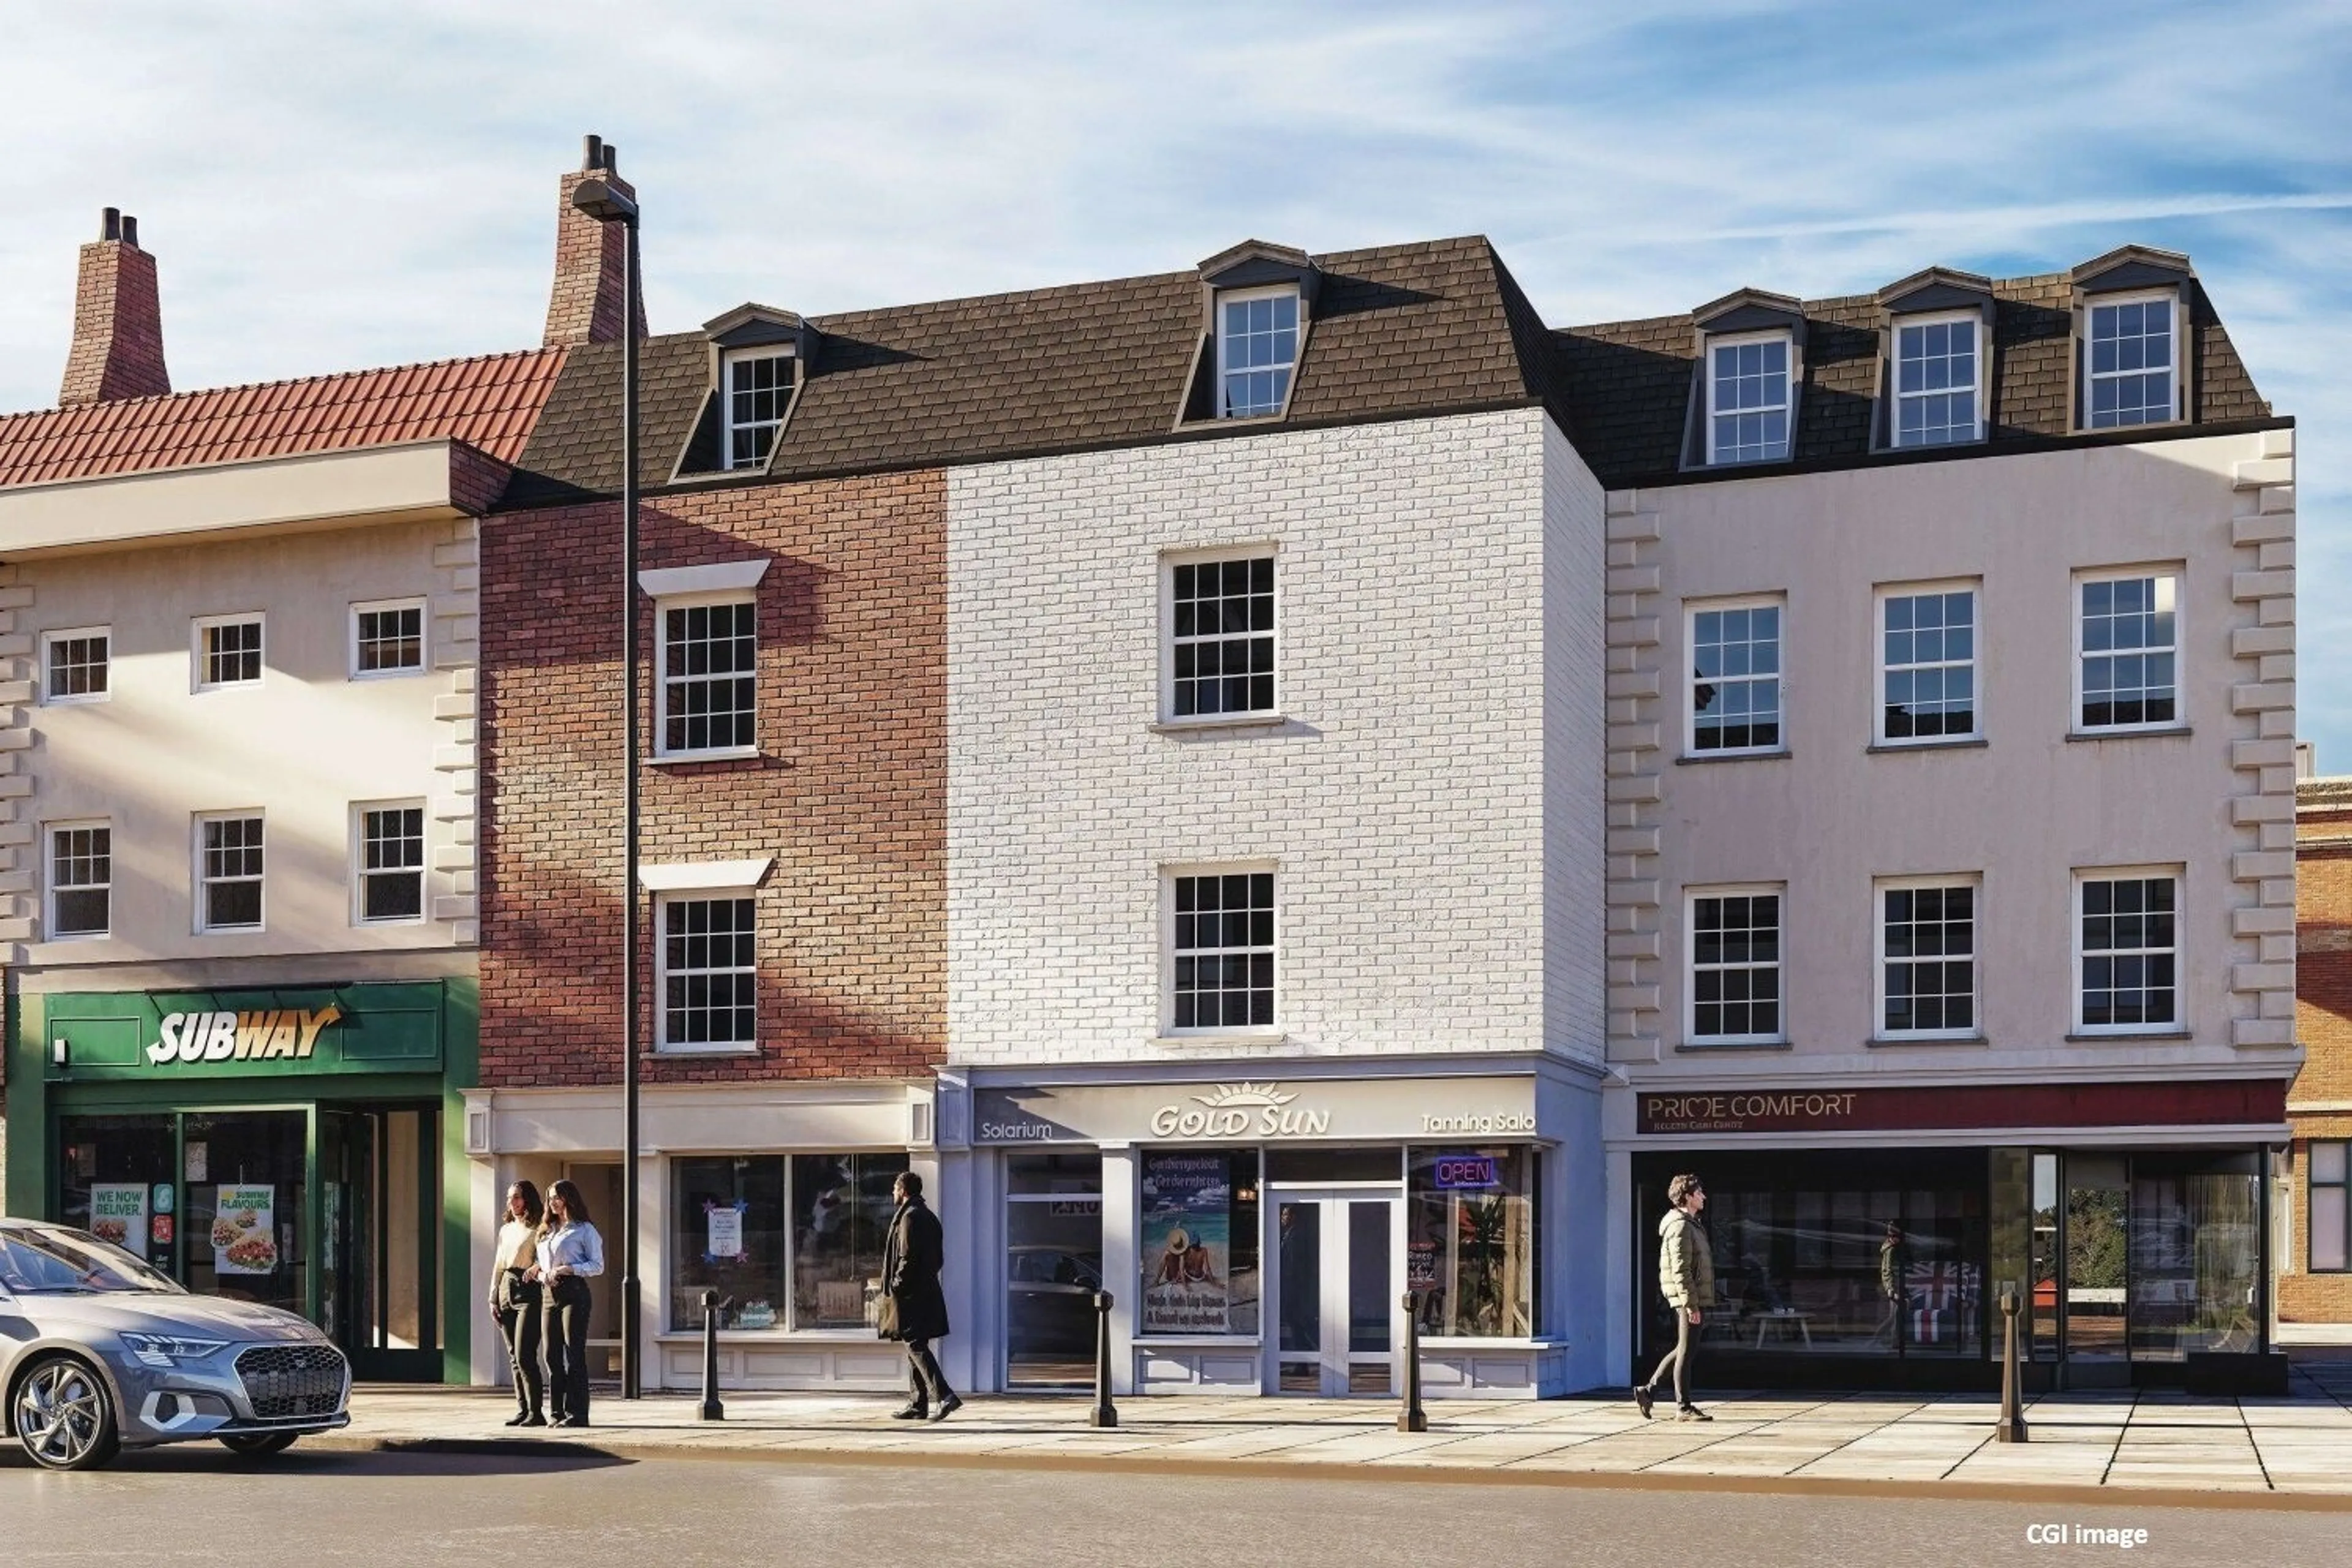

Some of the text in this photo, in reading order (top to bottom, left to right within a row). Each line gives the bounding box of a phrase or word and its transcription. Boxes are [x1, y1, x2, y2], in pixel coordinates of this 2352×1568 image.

[145, 1003, 341, 1065] SUBWAY
[1731, 1094, 1857, 1117] COMFORT
[981, 1121, 1052, 1139] Solarium
[1150, 1104, 1330, 1137] GOLD SUN
[1439, 1163, 1490, 1181] OPEN
[96, 1191, 142, 1202] WE NOW
